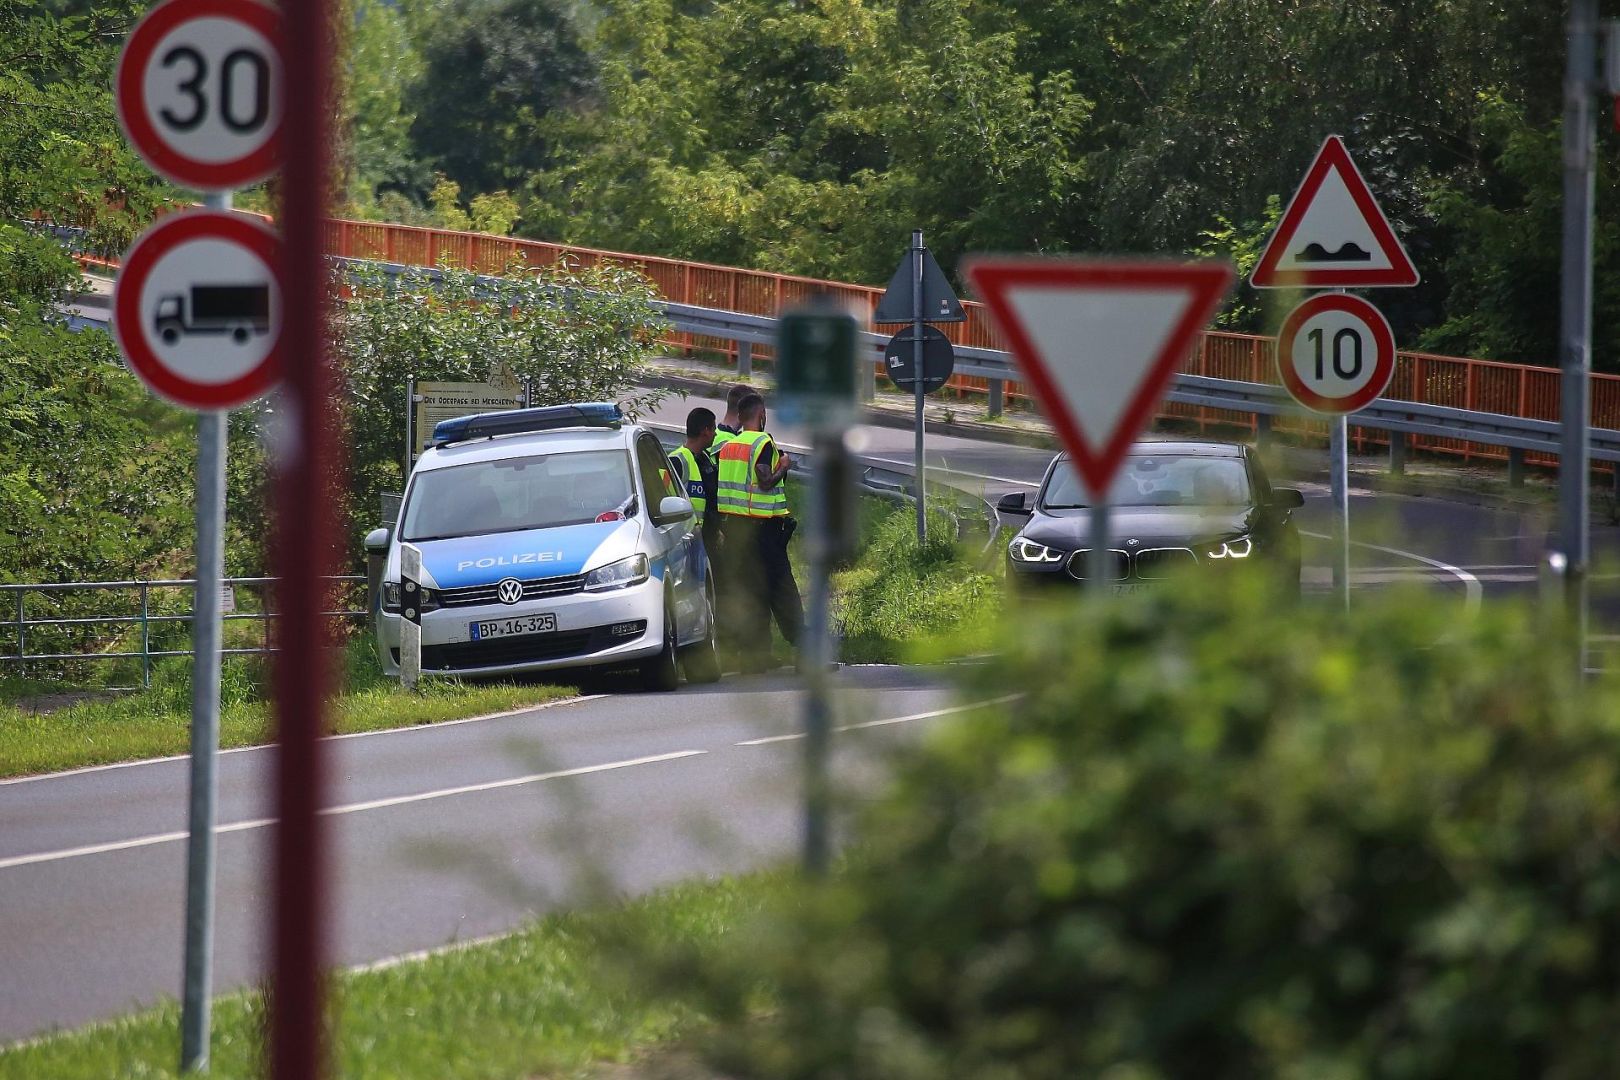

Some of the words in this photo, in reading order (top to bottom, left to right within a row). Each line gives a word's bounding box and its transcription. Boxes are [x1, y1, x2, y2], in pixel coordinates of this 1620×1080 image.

[161, 46, 270, 134] 30
[1308, 328, 1362, 381] 10
[691, 485, 705, 495] PO
[457, 551, 563, 572] POLIZEI
[480, 623, 498, 638] BP
[505, 616, 554, 635] 16-325
